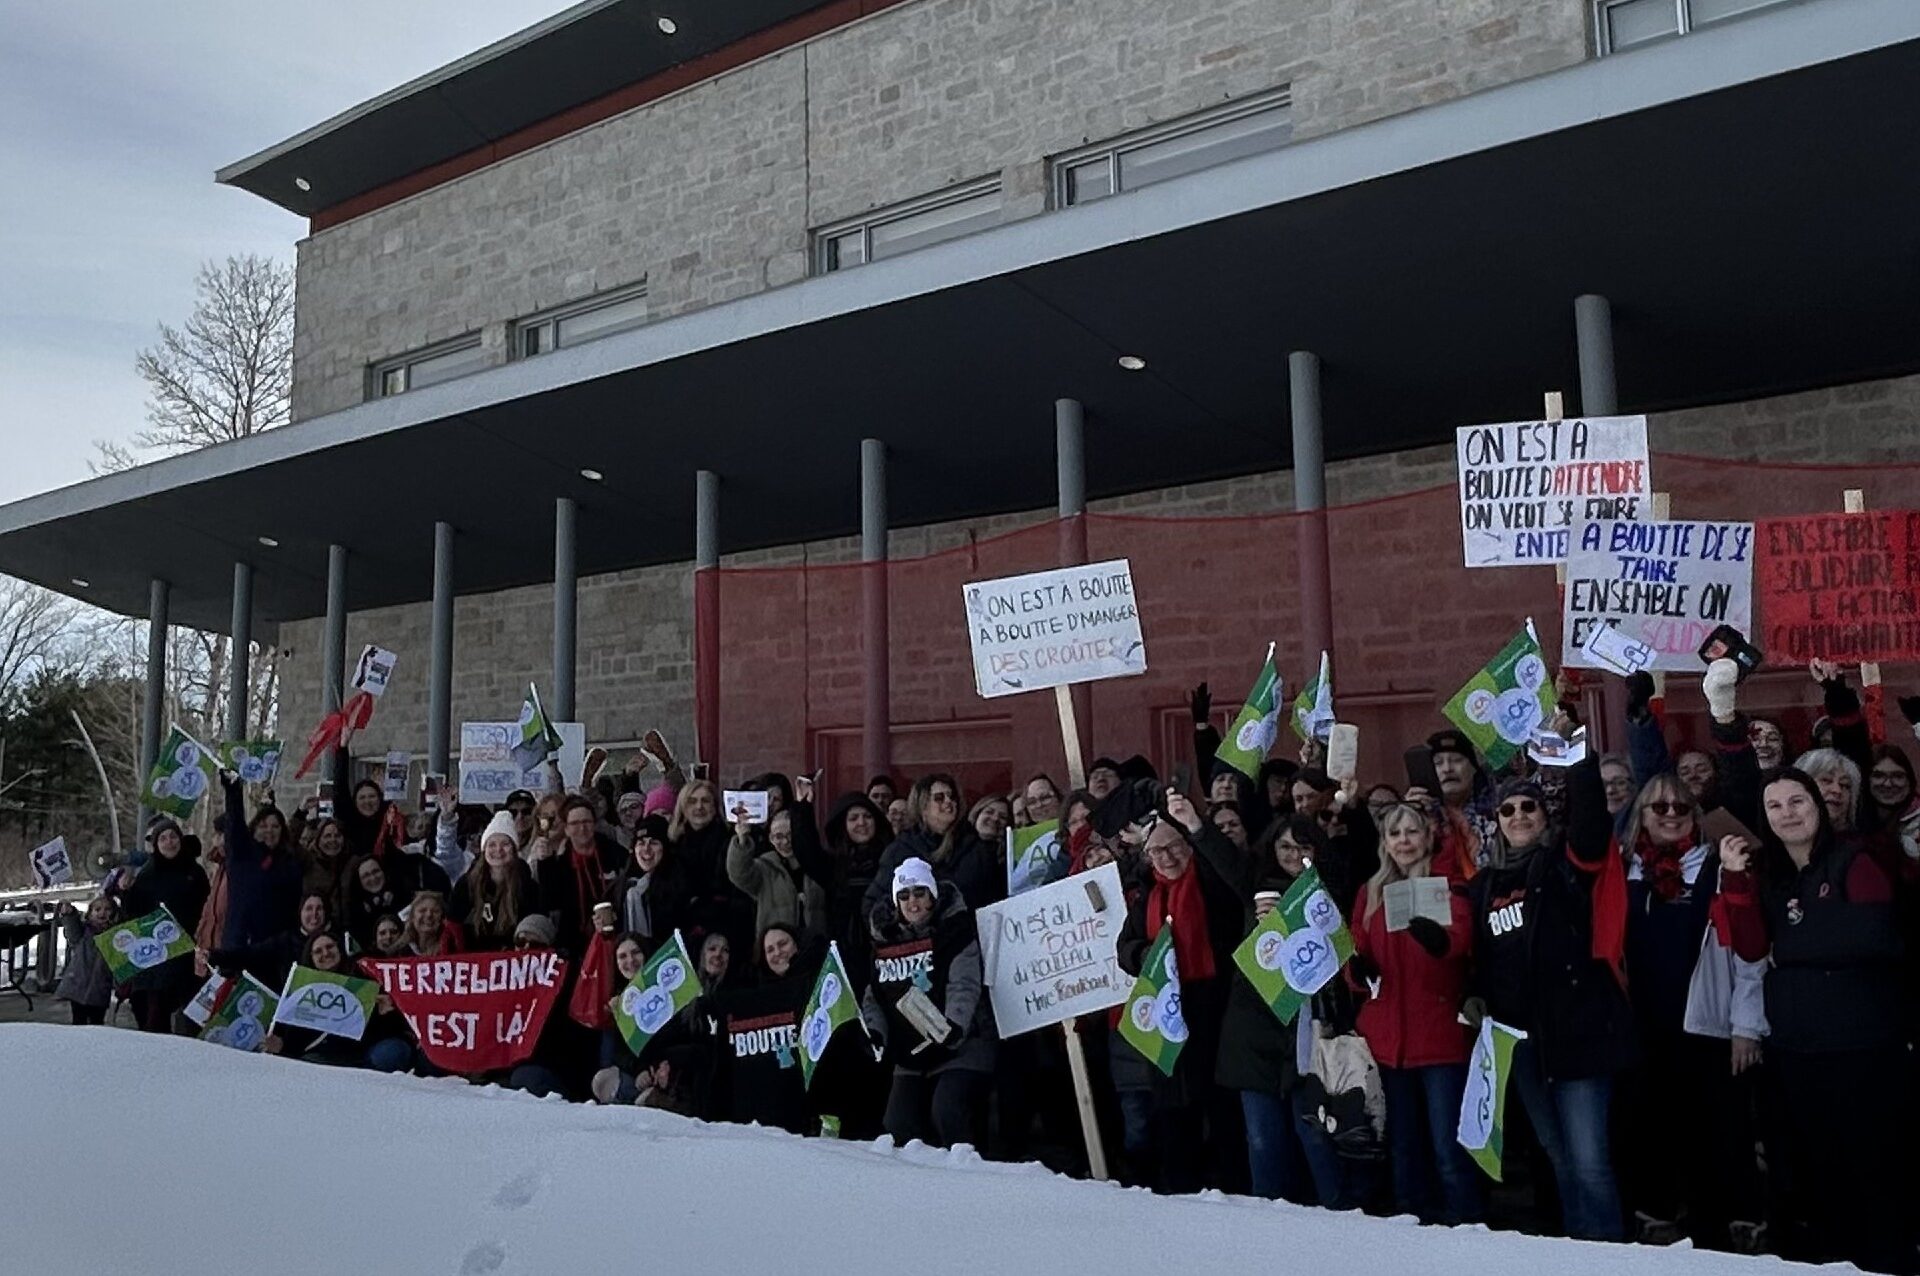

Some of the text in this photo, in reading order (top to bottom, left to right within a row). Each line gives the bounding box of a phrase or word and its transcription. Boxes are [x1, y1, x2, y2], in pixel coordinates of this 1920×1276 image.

[1466, 427, 1504, 466] ON
[1517, 421, 1560, 462] EST
[1465, 466, 1536, 500] BOUTTE
[1465, 503, 1492, 530] ON
[1500, 501, 1547, 528] VEUT
[1515, 530, 1571, 559] ENTE
[1582, 523, 1601, 551] A
[1609, 522, 1695, 558] BOUTTE
[1618, 555, 1679, 584] TAIRE
[988, 593, 1016, 618] ON
[1021, 586, 1055, 613] EST
[1079, 573, 1132, 601] BOUTTE
[1571, 578, 1732, 622] ENSEMBLE ON
[995, 616, 1063, 644] BOUTTE
[989, 650, 1030, 676] DES
[1028, 841, 1063, 871] AC
[1290, 940, 1324, 977] ACA
[297, 988, 346, 1014] ACA
[427, 1011, 480, 1050] EST
